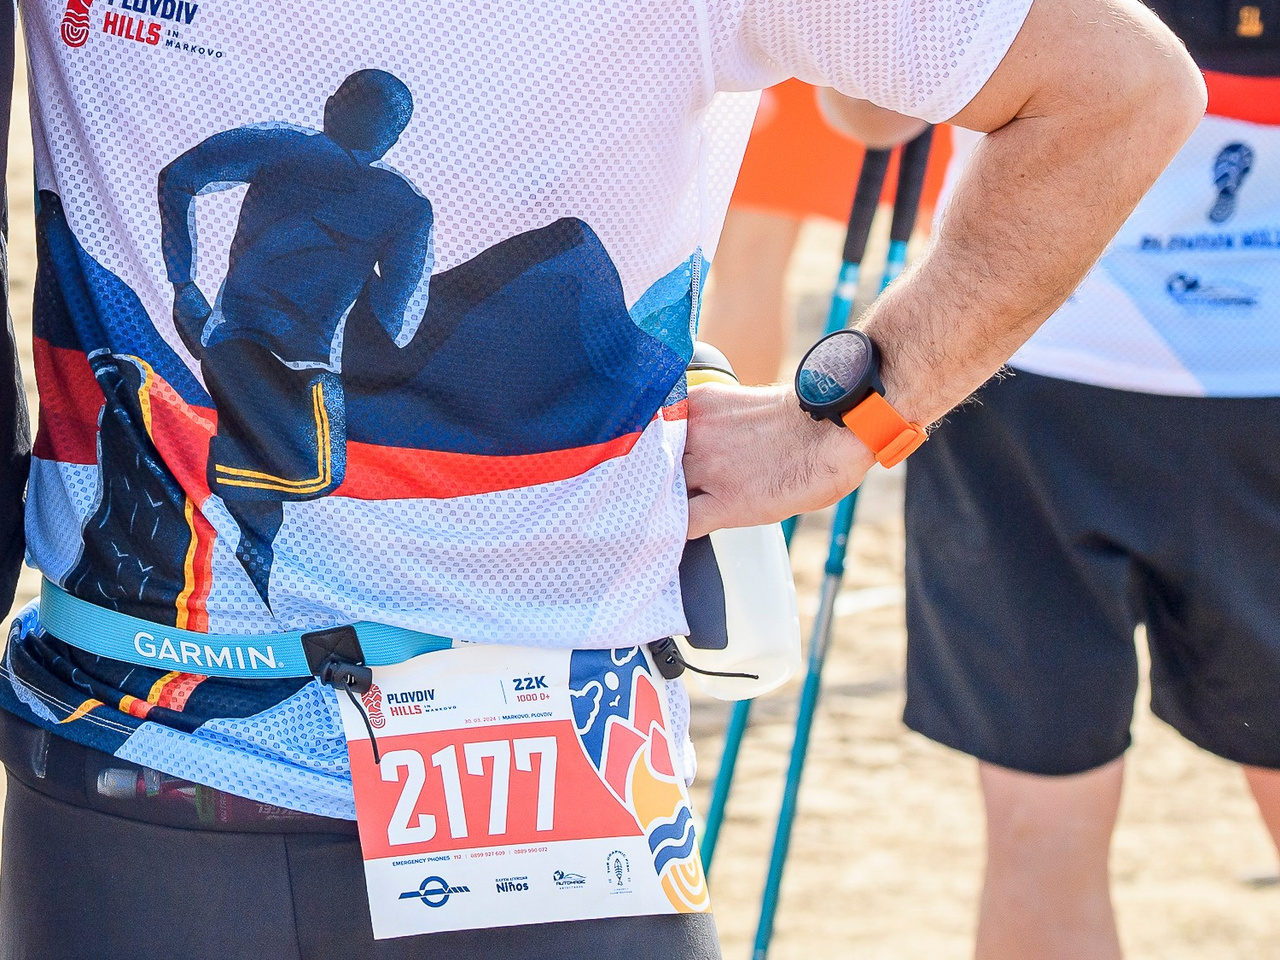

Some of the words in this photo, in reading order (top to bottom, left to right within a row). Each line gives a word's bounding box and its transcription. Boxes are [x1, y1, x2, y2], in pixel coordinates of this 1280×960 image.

[102, 11, 161, 46] HILLS
[166, 29, 179, 38] IN
[165, 39, 223, 58] MARKOVO
[133, 631, 278, 670] GARMIN
[513, 675, 549, 691] 22K
[386, 689, 435, 704] PLOVDIV
[517, 693, 538, 702] 1000
[539, 693, 550, 701] D+
[389, 705, 423, 716] HILLS
[379, 736, 558, 846] 2177
[392, 857, 426, 866] EMERGENCY
